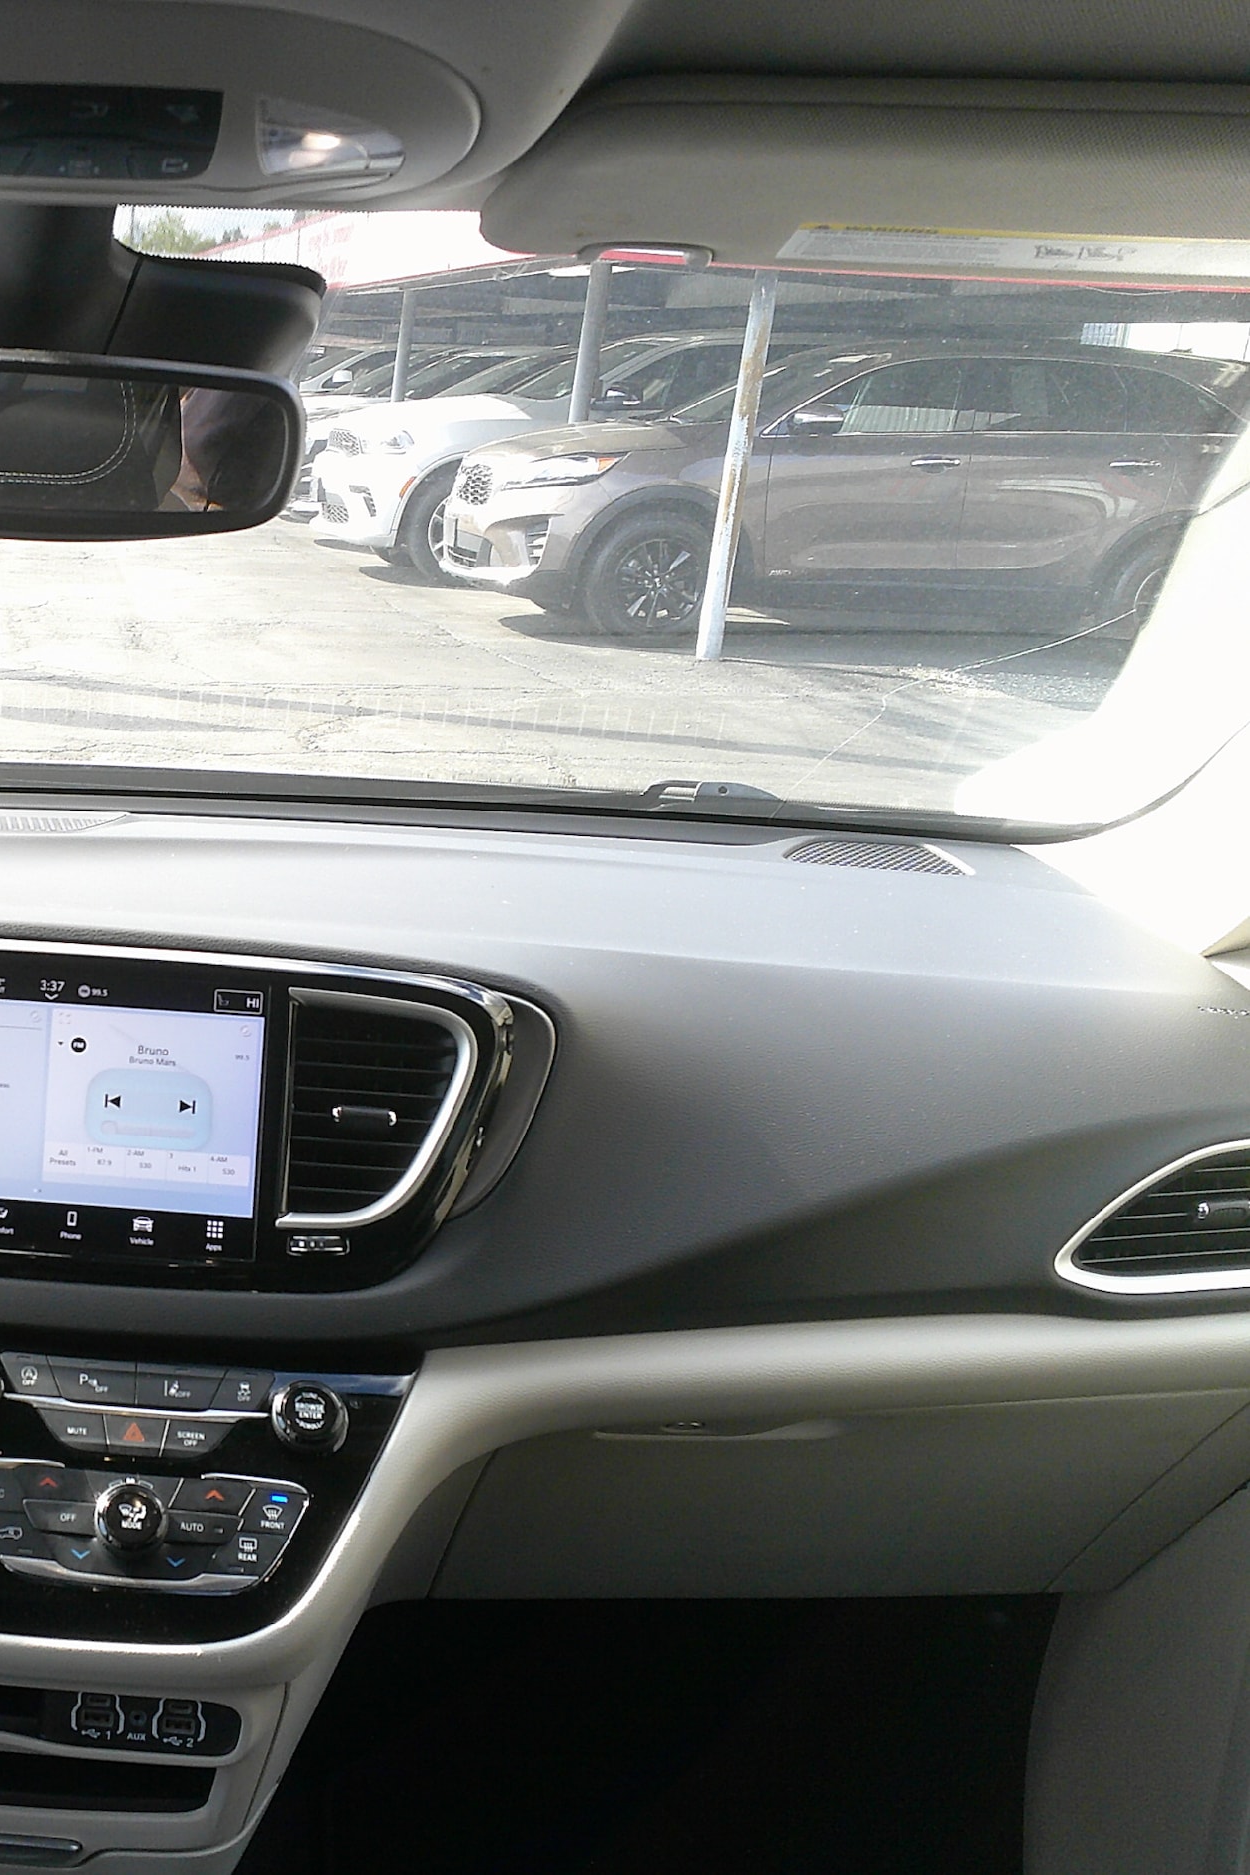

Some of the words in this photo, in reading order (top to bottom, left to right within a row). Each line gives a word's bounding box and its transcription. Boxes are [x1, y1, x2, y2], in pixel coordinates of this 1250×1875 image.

[39, 979, 65, 992] 3:37
[91, 988, 108, 997] 99.5
[245, 997, 260, 1009] HI
[137, 1045, 170, 1056] Bruno
[129, 1056, 154, 1065] Bruno
[156, 1057, 177, 1067] Mars
[49, 1158, 77, 1167] Presets
[60, 1230, 82, 1241] Phone
[129, 1236, 154, 1246] Vehicle
[205, 1242, 223, 1253] Apps
[67, 1426, 88, 1436] MUTE
[177, 1430, 206, 1441] SCREEN
[183, 1438, 198, 1447] OFF
[60, 1513, 77, 1523] OFF
[121, 1520, 143, 1531] MODE
[180, 1521, 205, 1533] AUTO
[260, 1519, 286, 1530] FRONT
[238, 1552, 258, 1562] REAR
[105, 1731, 111, 1741] 1
[127, 1731, 147, 1742] AUX
[186, 1737, 194, 1748] 2
